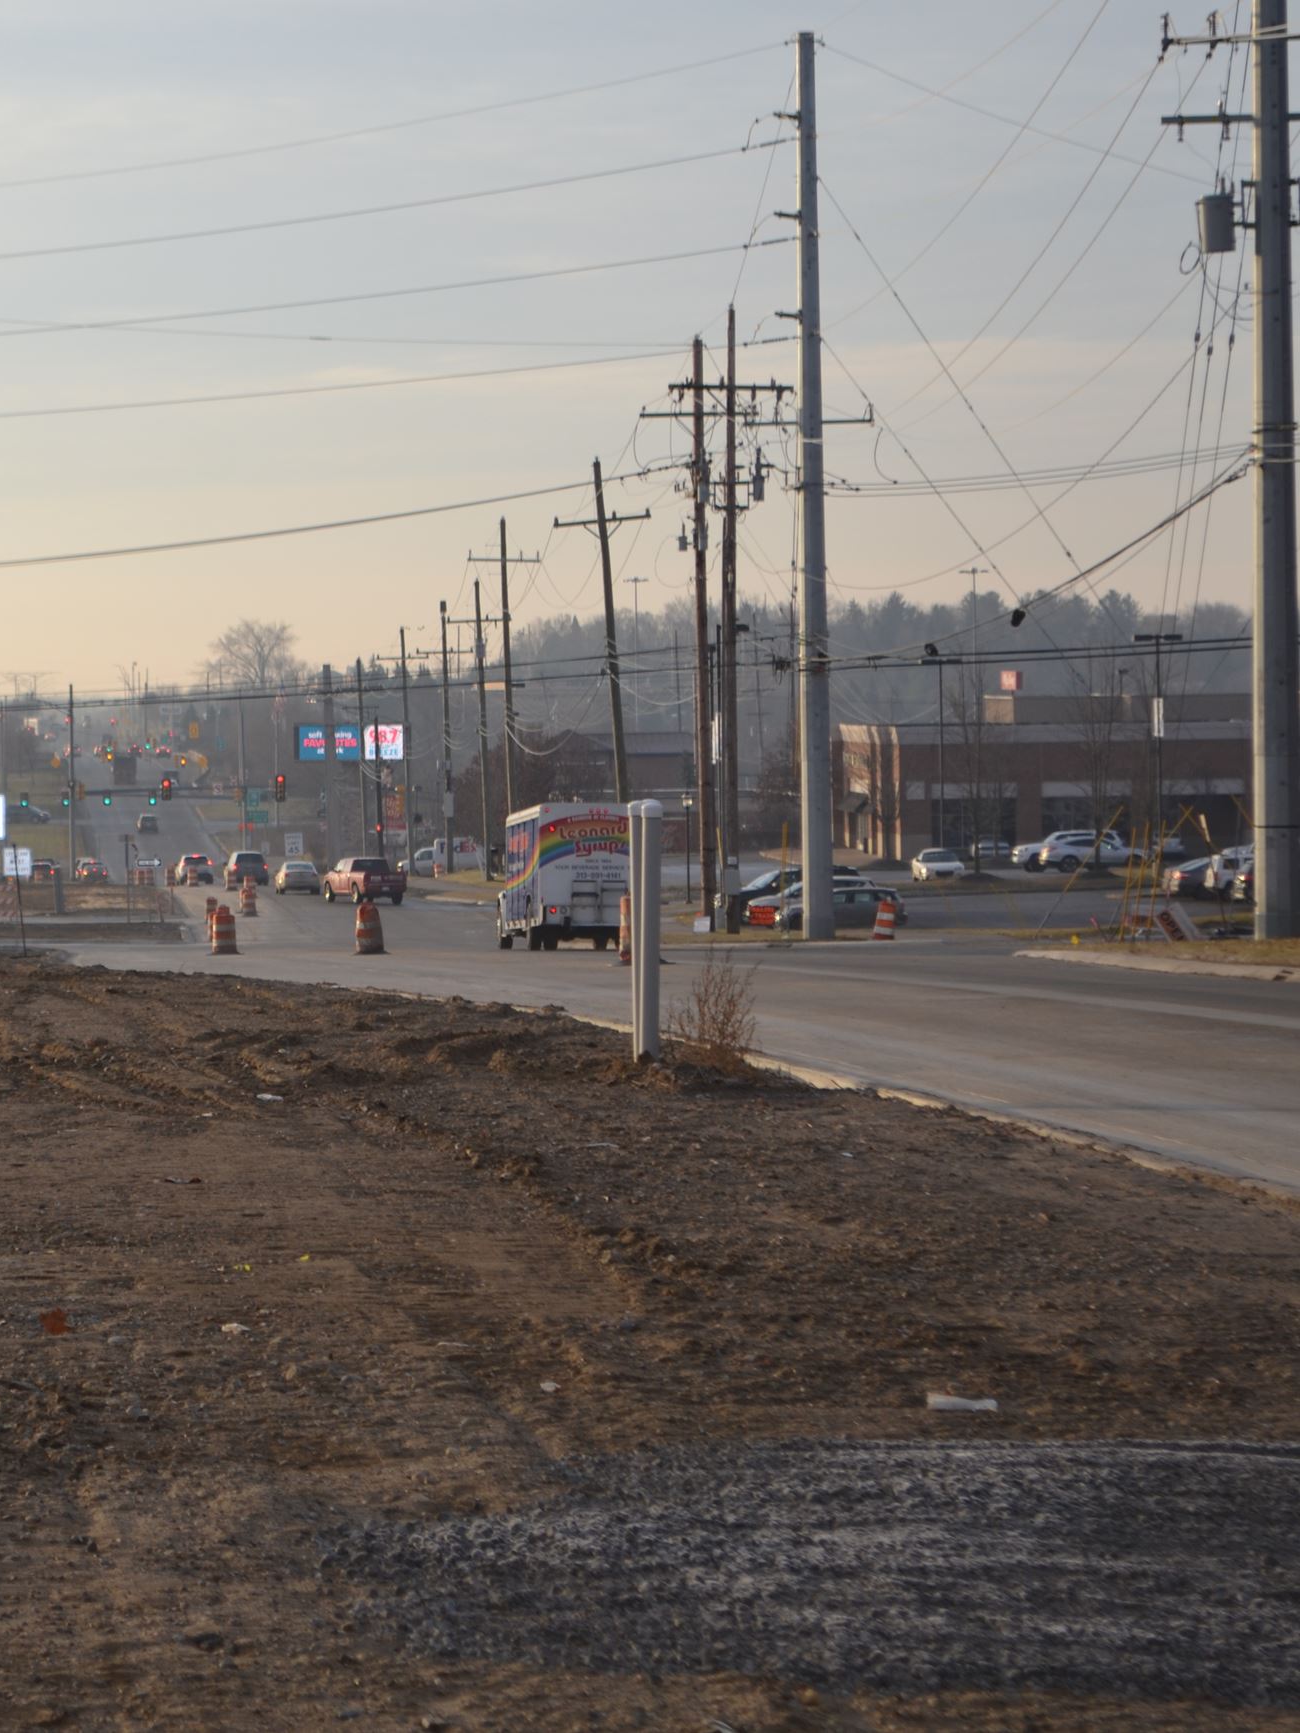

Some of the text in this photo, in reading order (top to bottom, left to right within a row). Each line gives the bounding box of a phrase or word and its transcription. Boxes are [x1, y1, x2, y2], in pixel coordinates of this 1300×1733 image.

[369, 728, 398, 743] 98.7
[304, 738, 357, 747] FAVITES
[288, 846, 300, 854] 45
[440, 842, 476, 853] FdEx
